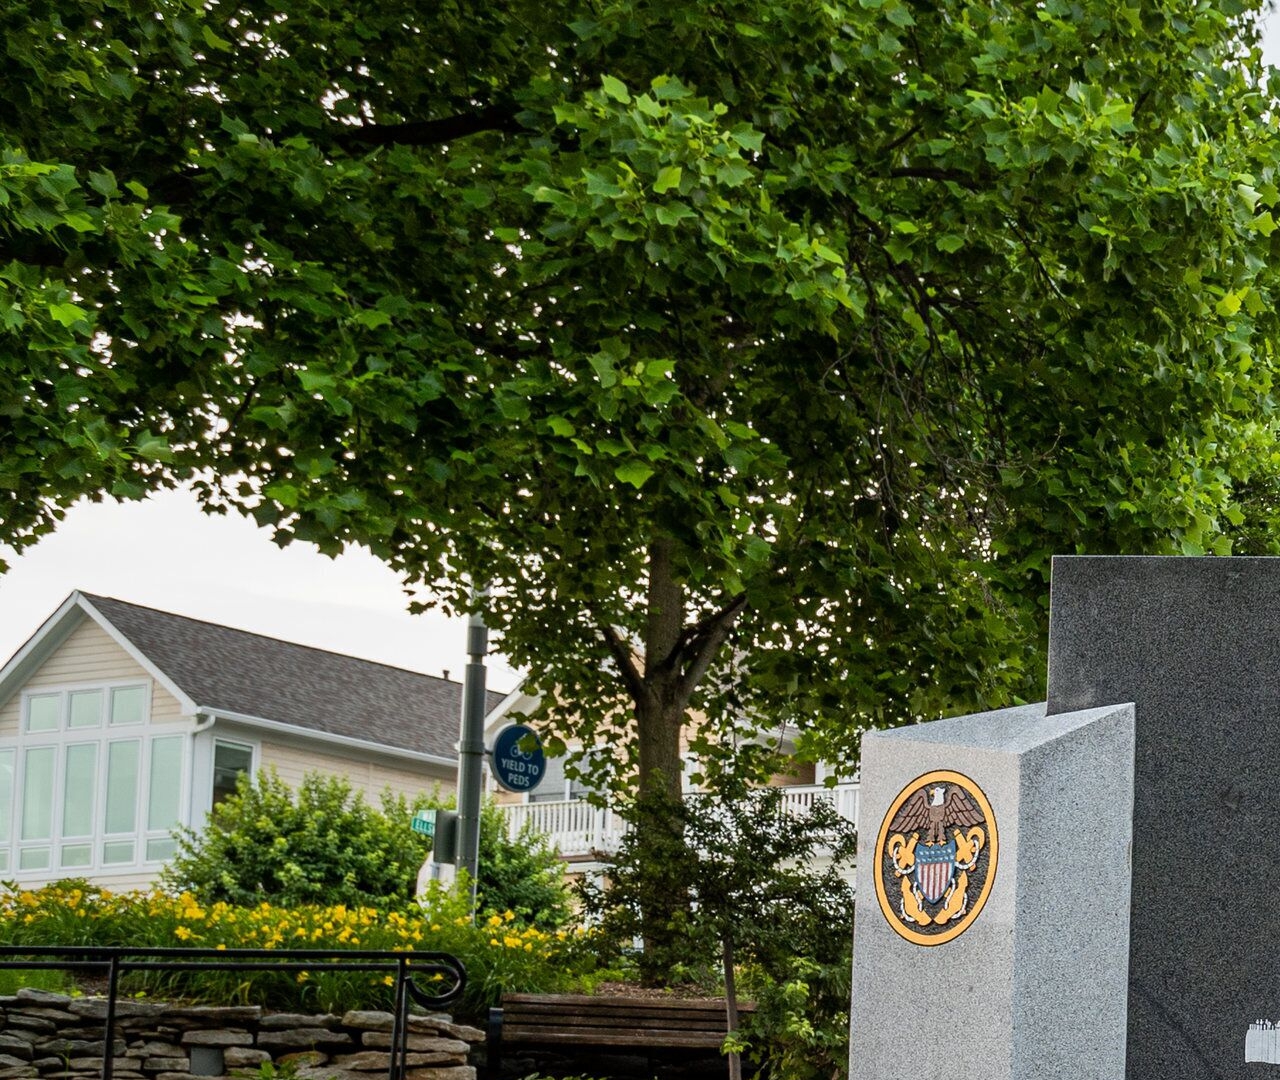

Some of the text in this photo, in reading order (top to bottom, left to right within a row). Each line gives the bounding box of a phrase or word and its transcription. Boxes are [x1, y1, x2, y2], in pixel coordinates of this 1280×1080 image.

[501, 758, 539, 776] YIELD TO
[508, 773, 530, 787] PEDS
